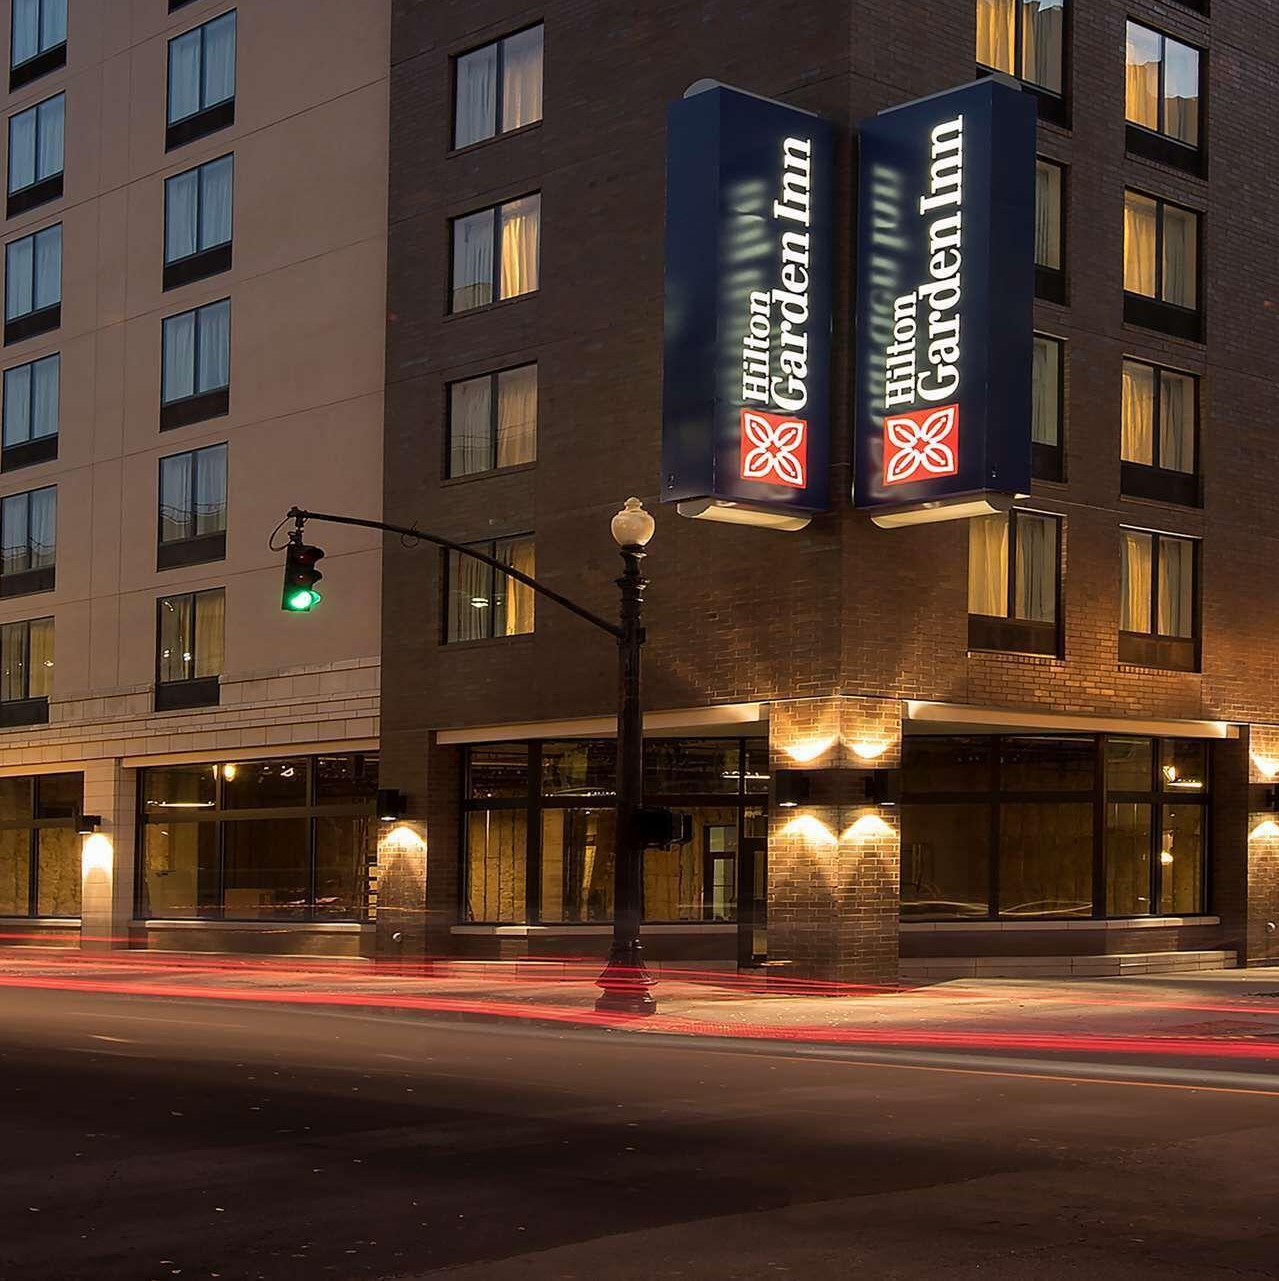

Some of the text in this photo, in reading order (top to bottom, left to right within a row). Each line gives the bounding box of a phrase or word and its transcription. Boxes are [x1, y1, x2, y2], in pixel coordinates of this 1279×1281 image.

[742, 289, 771, 406] Hilton
[770, 135, 811, 412] Garden Inn
[885, 290, 918, 410] Hilton
[916, 114, 963, 404] Garden Inn
